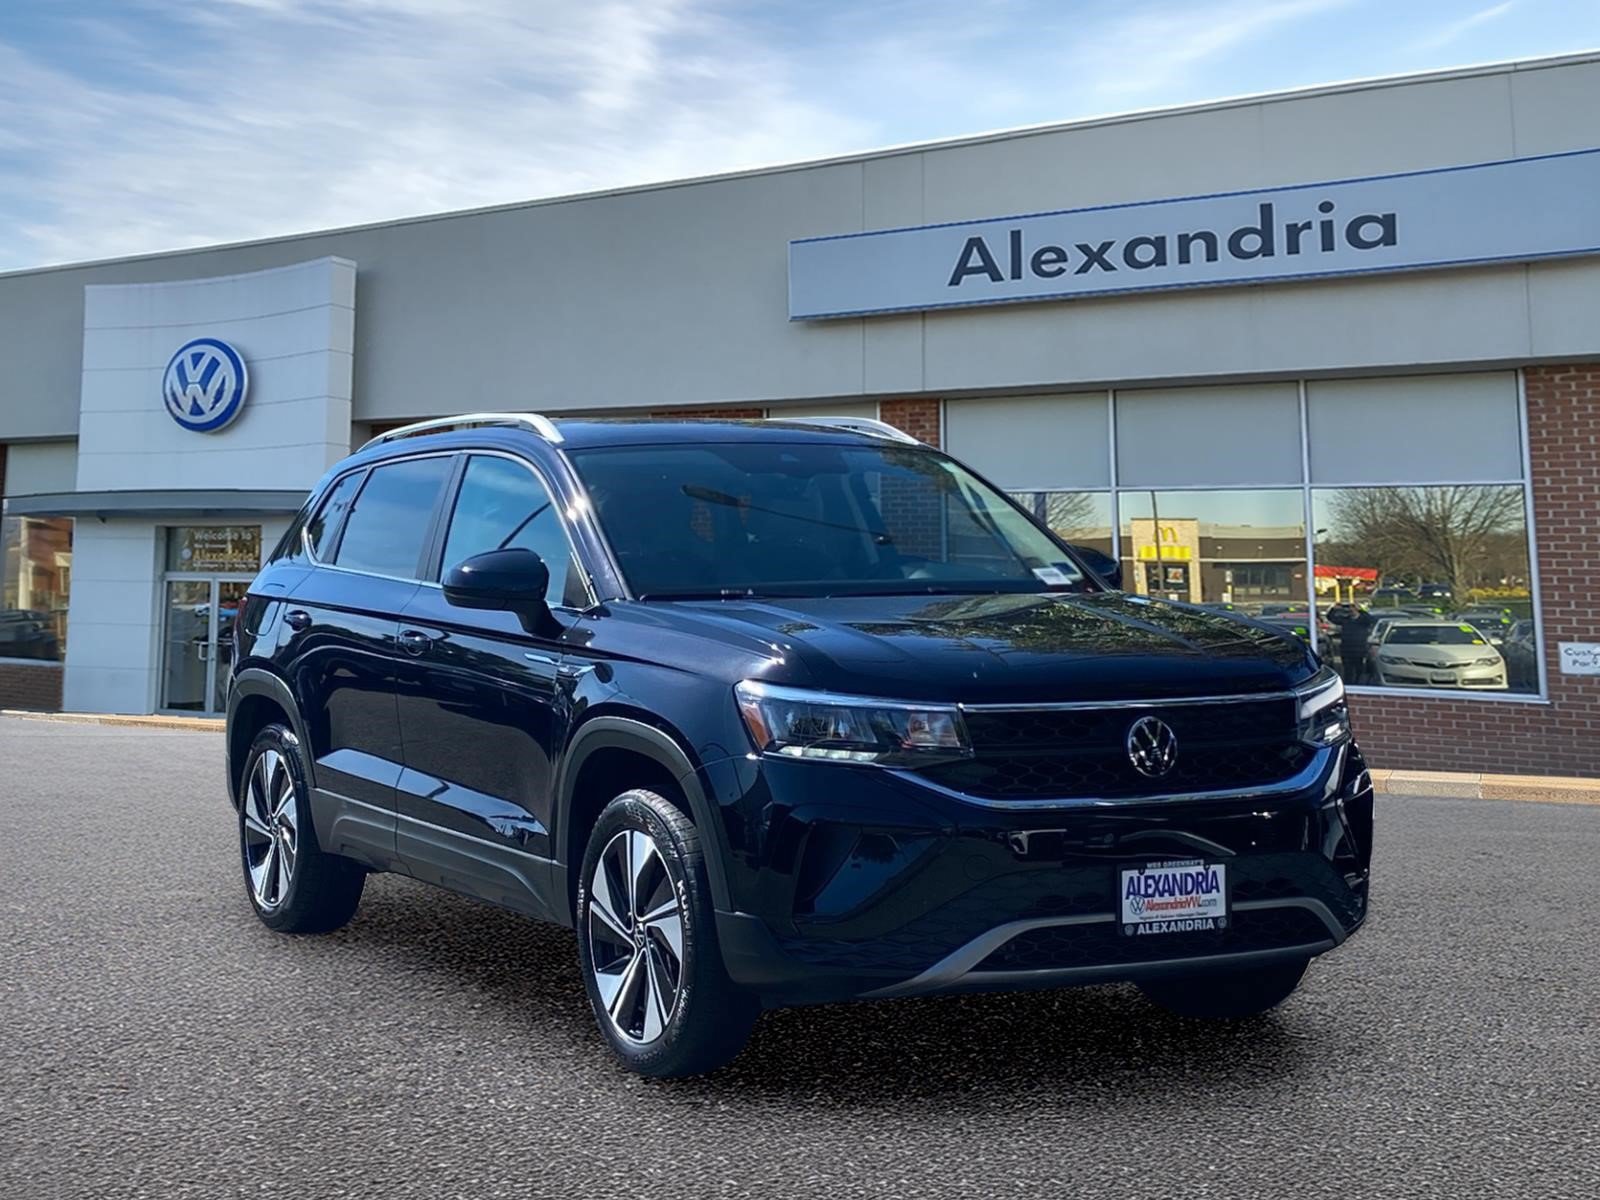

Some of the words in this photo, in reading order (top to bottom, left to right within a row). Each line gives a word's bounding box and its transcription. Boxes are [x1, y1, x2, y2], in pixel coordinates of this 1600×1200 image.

[947, 200, 1398, 287] Alexandria
[1125, 870, 1220, 900] ALEXANDRIA
[1137, 918, 1215, 935] ALEXANDRIA
